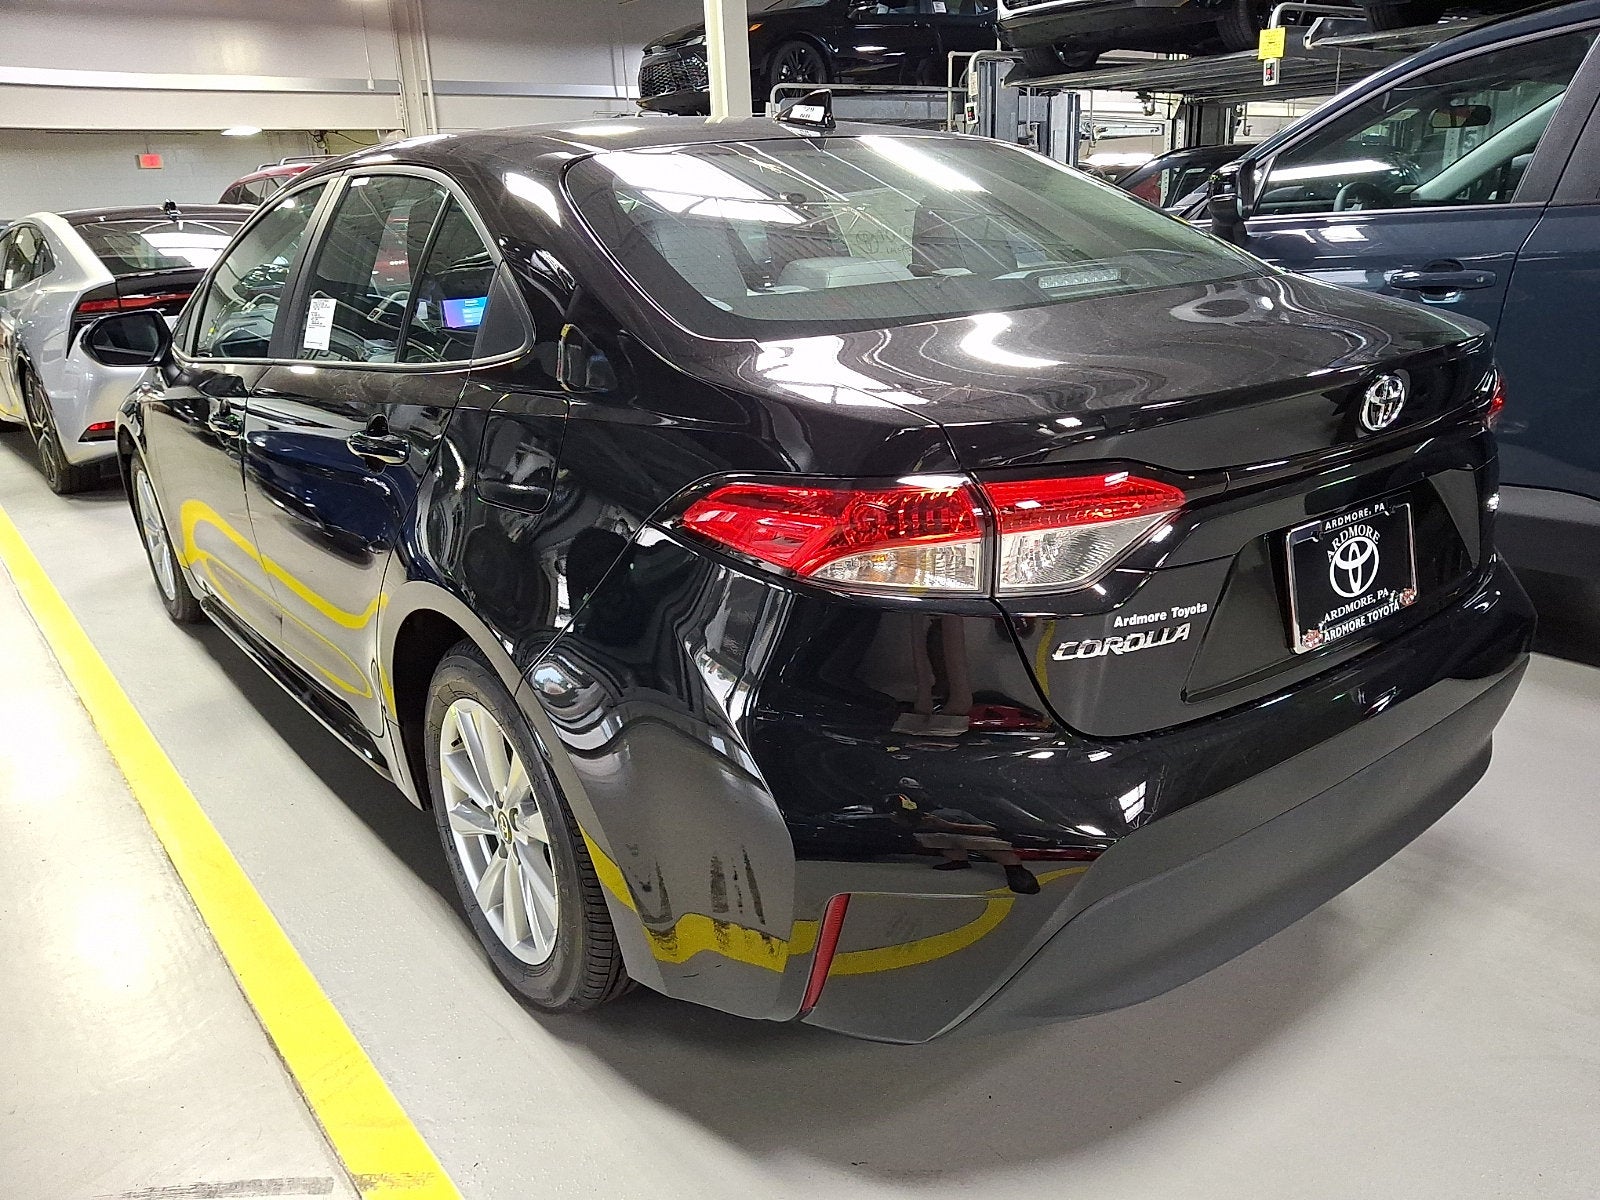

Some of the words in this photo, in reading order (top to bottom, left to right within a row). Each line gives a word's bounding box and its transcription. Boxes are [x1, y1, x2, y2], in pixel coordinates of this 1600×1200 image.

[1325, 508, 1372, 531] ARDMORE,
[1374, 502, 1385, 513] PA
[1327, 524, 1380, 562] ARDMORE
[1113, 610, 1167, 628] Ardmore
[1171, 602, 1208, 619] Toyota
[1323, 594, 1376, 623] ARDMORE,
[1377, 587, 1389, 598] PA
[1324, 613, 1366, 642] ARDMORE
[1369, 600, 1399, 621] TOYOTA
[1051, 622, 1191, 661] COROLLA
